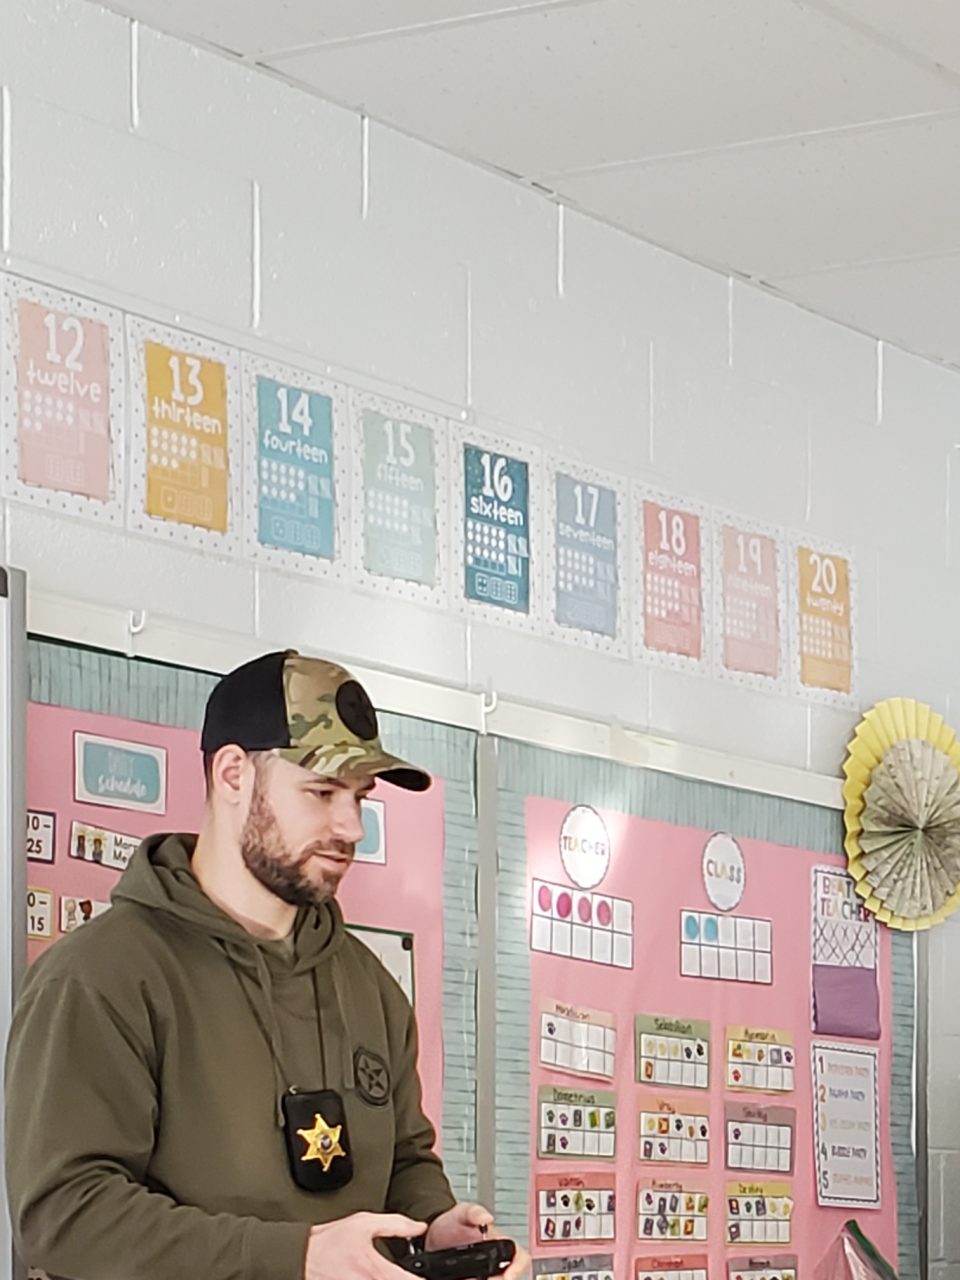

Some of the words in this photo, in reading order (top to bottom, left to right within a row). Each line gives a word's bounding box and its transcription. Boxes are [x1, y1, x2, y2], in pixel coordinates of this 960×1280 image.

[44, 312, 84, 372] 12
[26, 359, 102, 403] twelve
[169, 355, 204, 406] 13
[151, 396, 222, 435] thirteen
[277, 387, 313, 436] 14
[262, 429, 329, 465] fourteen
[383, 420, 417, 469] 15
[376, 463, 424, 493] fifteen
[481, 453, 513, 502] 16
[470, 495, 524, 527] sixteen
[574, 485, 600, 528] 17
[558, 520, 615, 551] seventeen
[658, 511, 686, 557] 18
[647, 552, 697, 578] eighteen
[736, 534, 762, 576] 19
[809, 554, 837, 595] 20
[706, 859, 742, 884] CLASS
[30, 915, 45, 932] 15
[820, 897, 871, 923] TEACHER
[819, 1084, 827, 1103] 2
[820, 1142, 829, 1161] 4
[822, 1170, 830, 1190] 5
